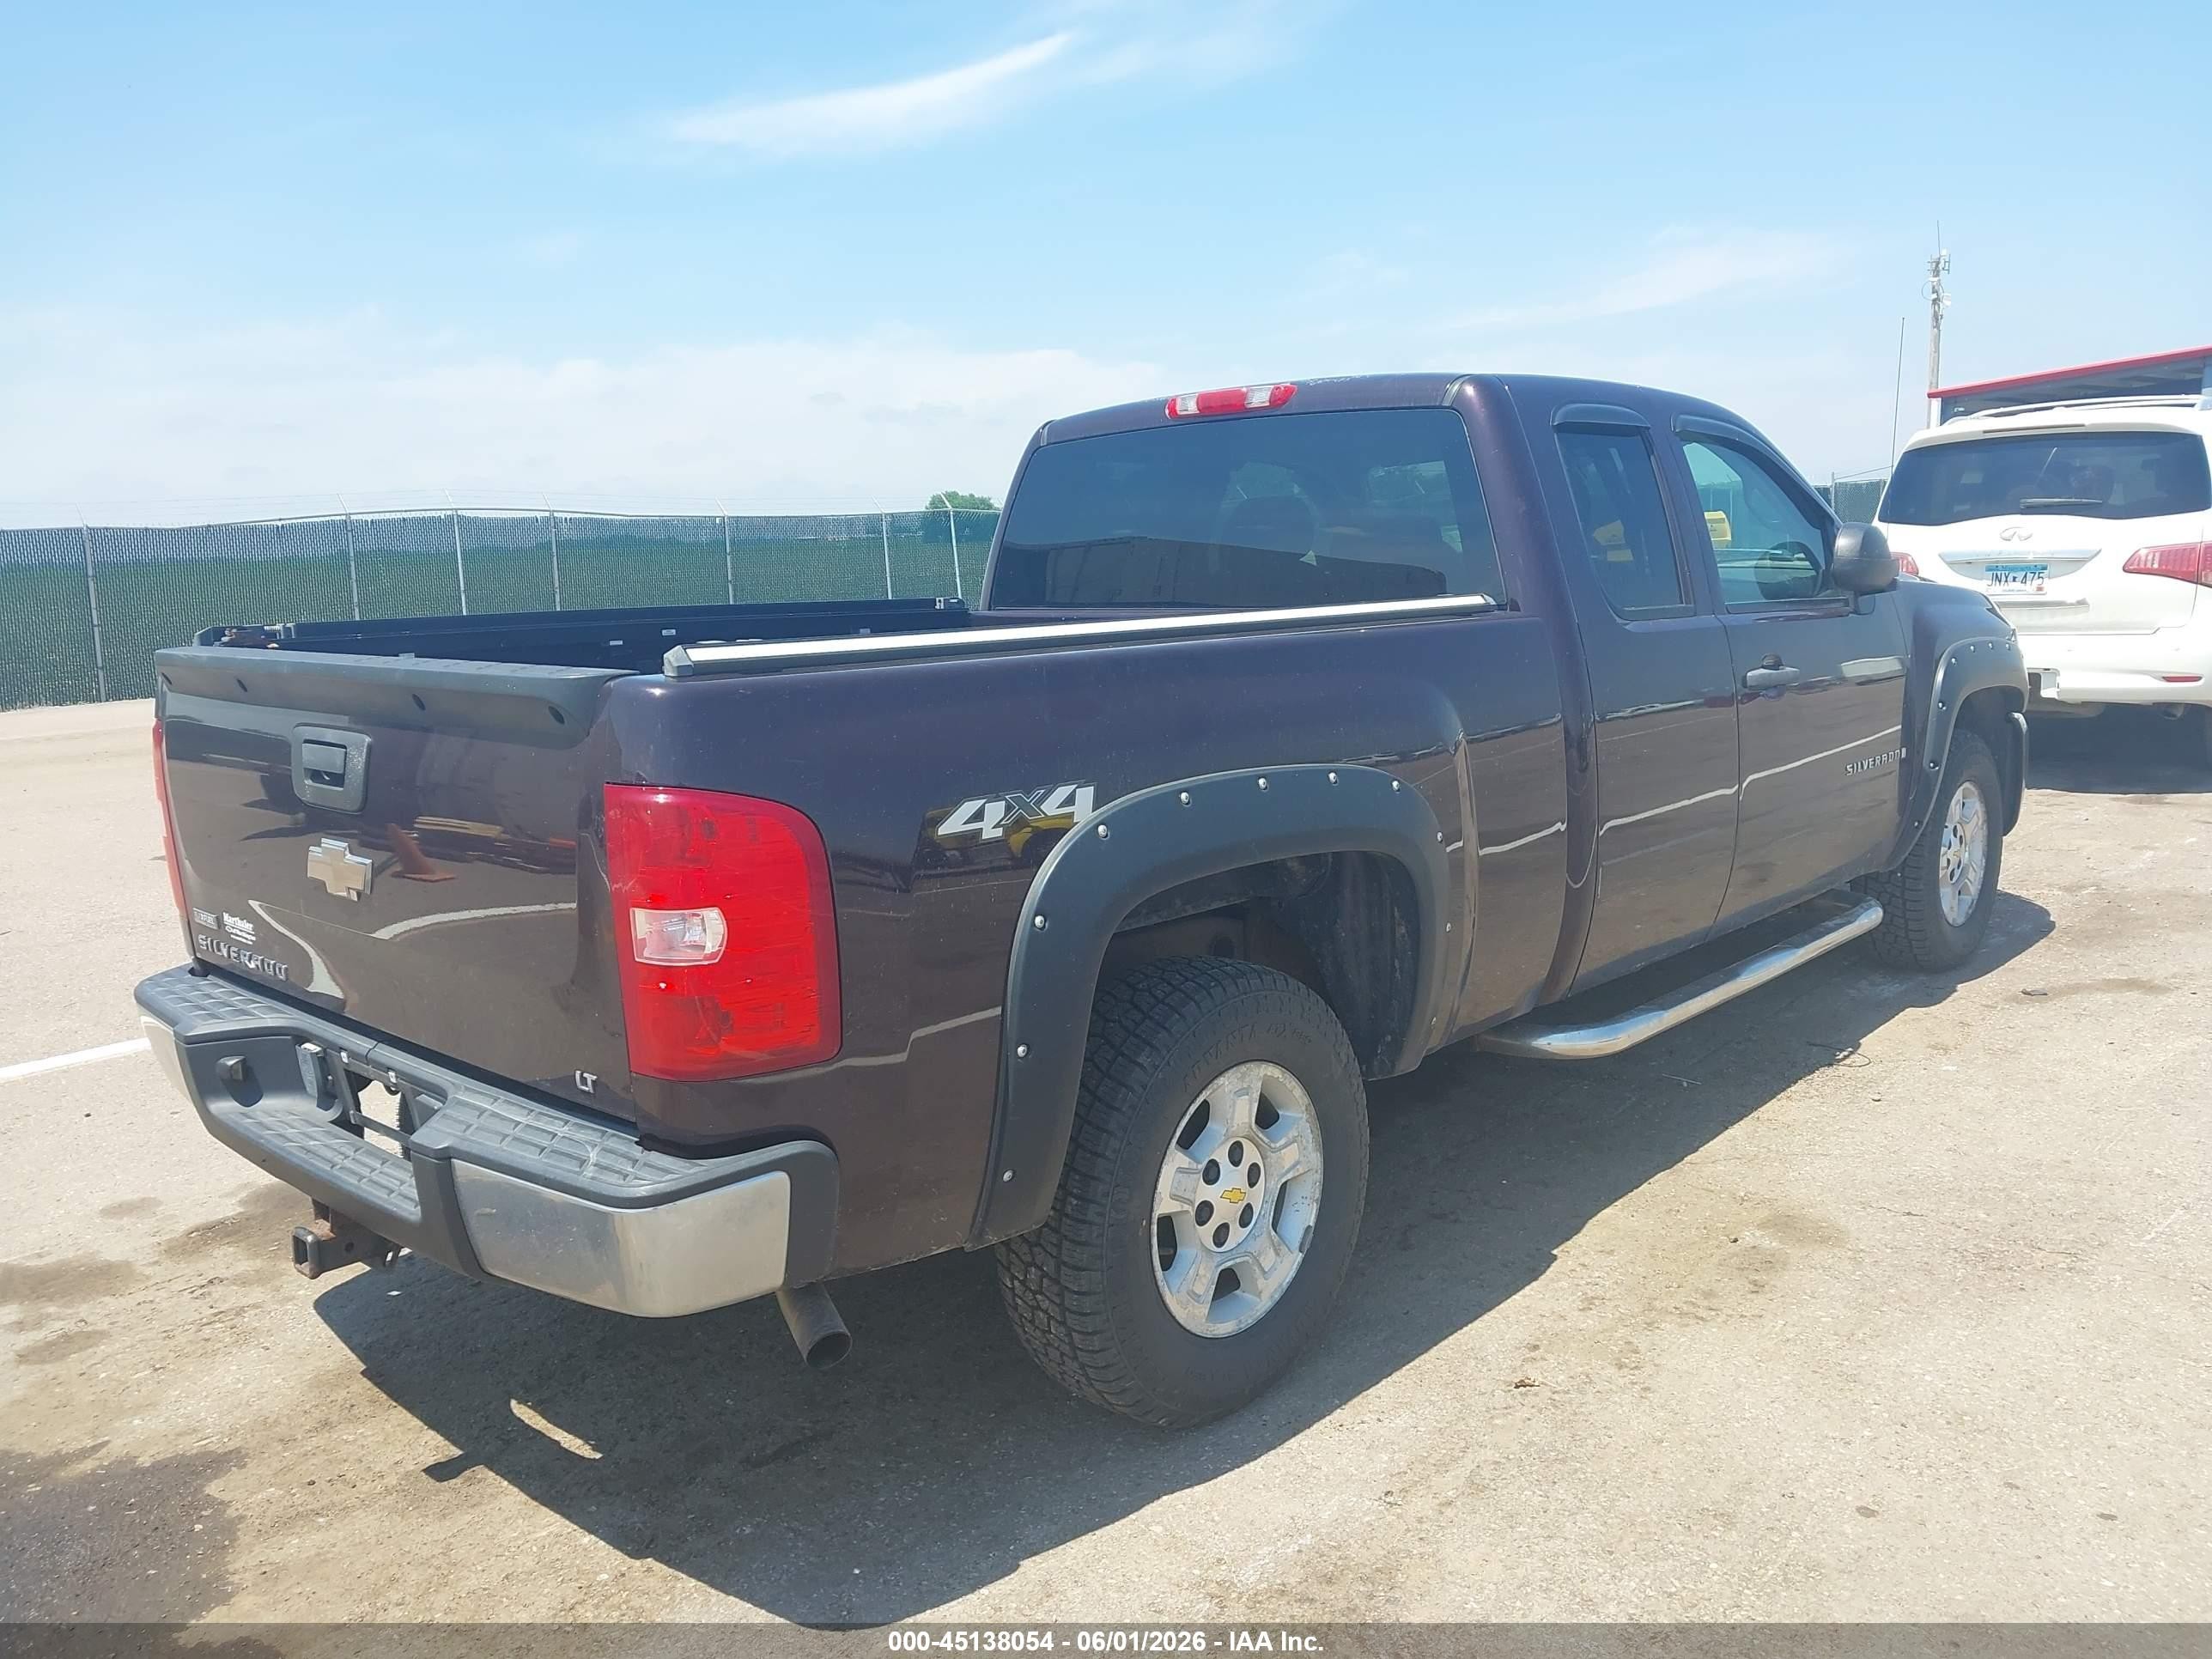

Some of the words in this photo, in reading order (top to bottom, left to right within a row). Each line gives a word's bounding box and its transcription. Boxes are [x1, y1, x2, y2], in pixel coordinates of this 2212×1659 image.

[1987, 571, 2010, 586] JNX
[2020, 571, 2045, 586] 475
[198, 934, 288, 981] SILVERADO
[575, 1070, 598, 1094] LT
